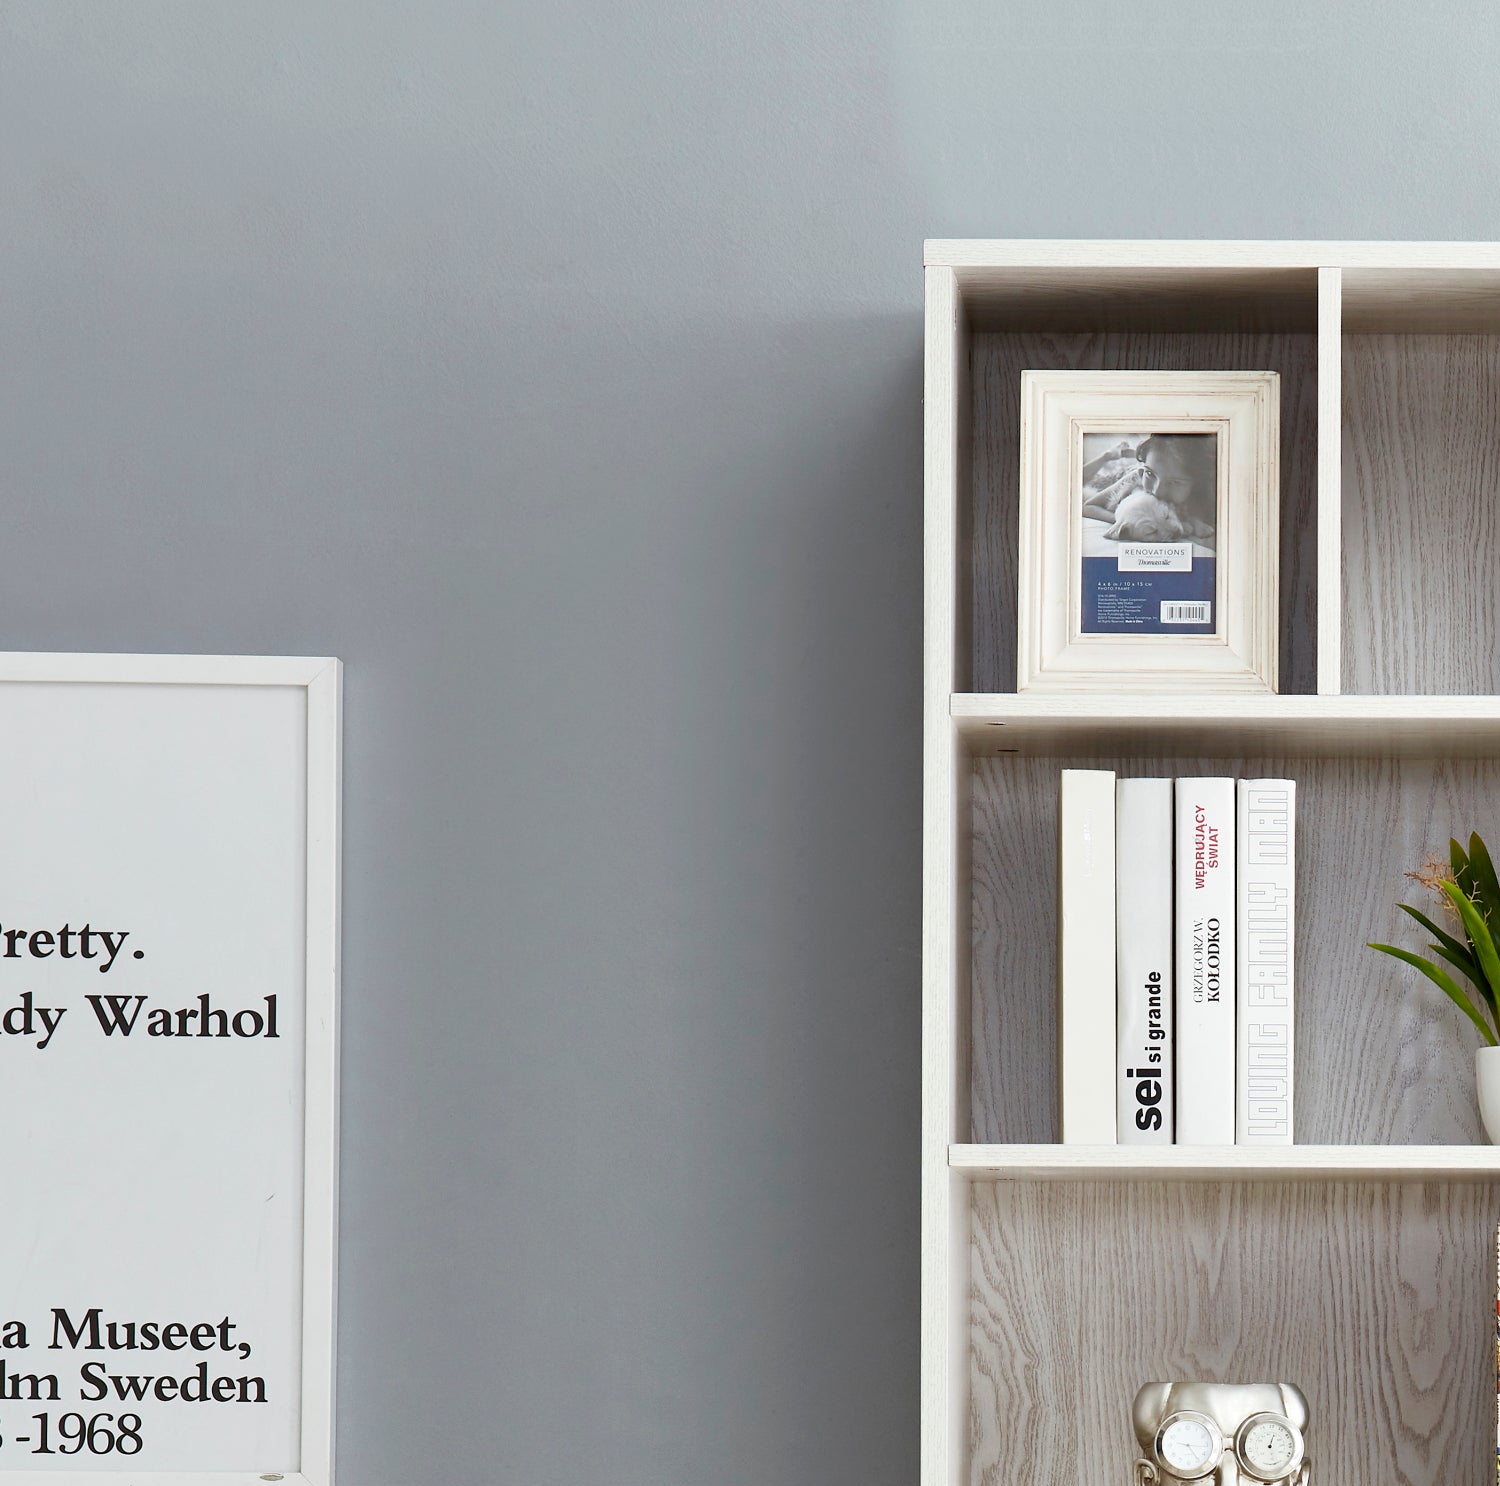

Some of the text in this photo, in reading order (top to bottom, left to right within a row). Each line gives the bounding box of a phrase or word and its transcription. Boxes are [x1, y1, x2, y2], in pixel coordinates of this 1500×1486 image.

[1195, 805, 1207, 890] WĘDRUJĄCY
[1206, 826, 1219, 868] ŚWIAT
[0, 923, 145, 973] retty.
[1193, 934, 1204, 1003] GRZEGORZ
[1207, 918, 1220, 1002] KOŁODKO
[84, 993, 280, 1038] Warhol
[1126, 971, 1166, 1131] sei si grande
[48, 1308, 252, 1360] Museet,
[80, 1361, 268, 1403] Sweden
